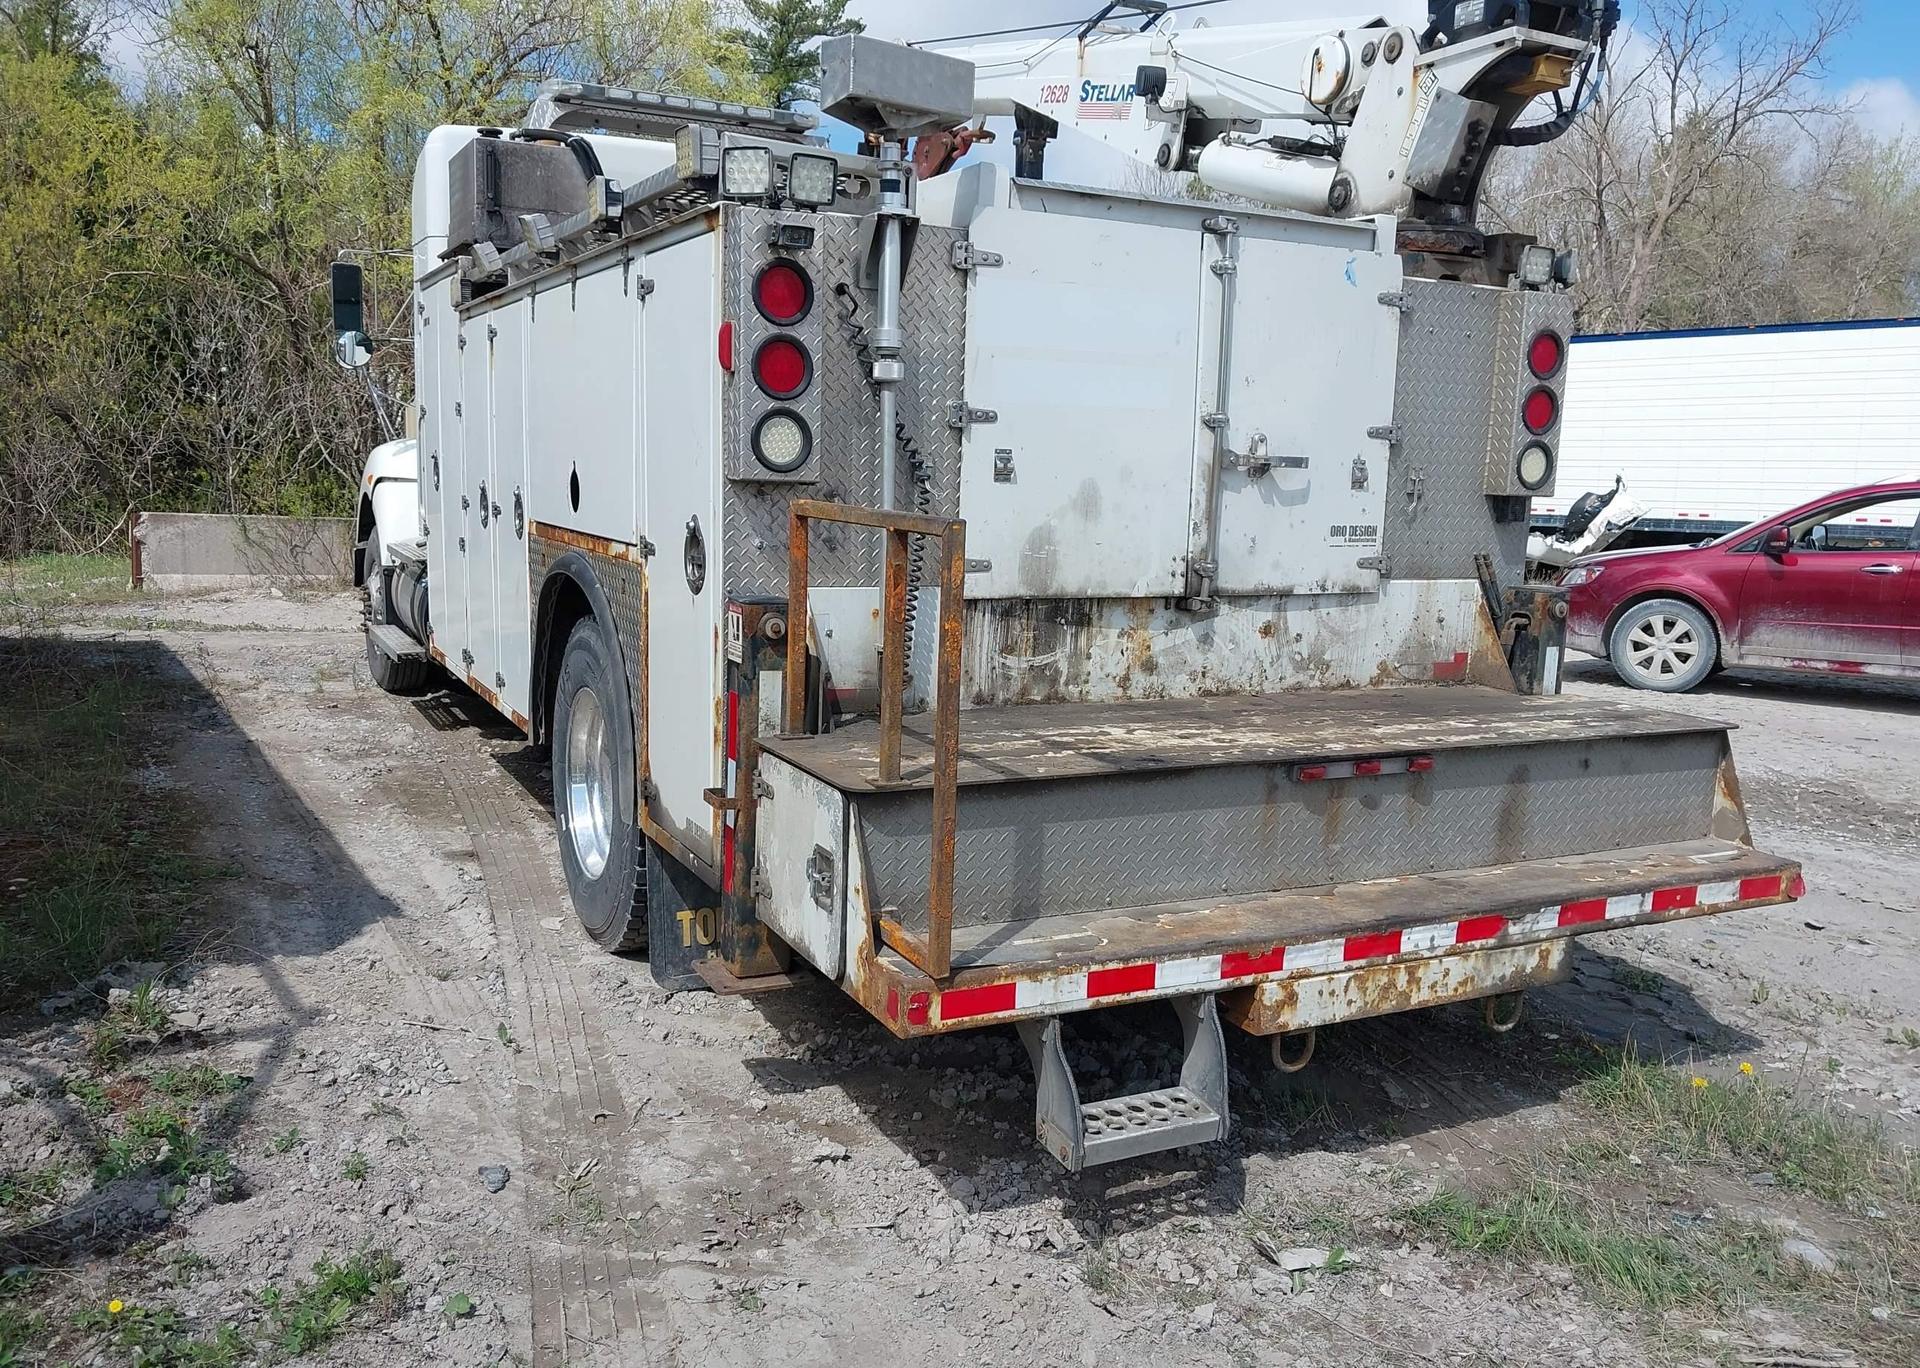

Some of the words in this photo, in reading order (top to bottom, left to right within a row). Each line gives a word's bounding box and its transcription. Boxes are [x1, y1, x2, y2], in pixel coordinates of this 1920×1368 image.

[1040, 84, 1070, 103] 12628
[1079, 79, 1136, 102] STELLAR
[1330, 525, 1347, 537] ORO
[1348, 525, 1377, 537] DESIGN
